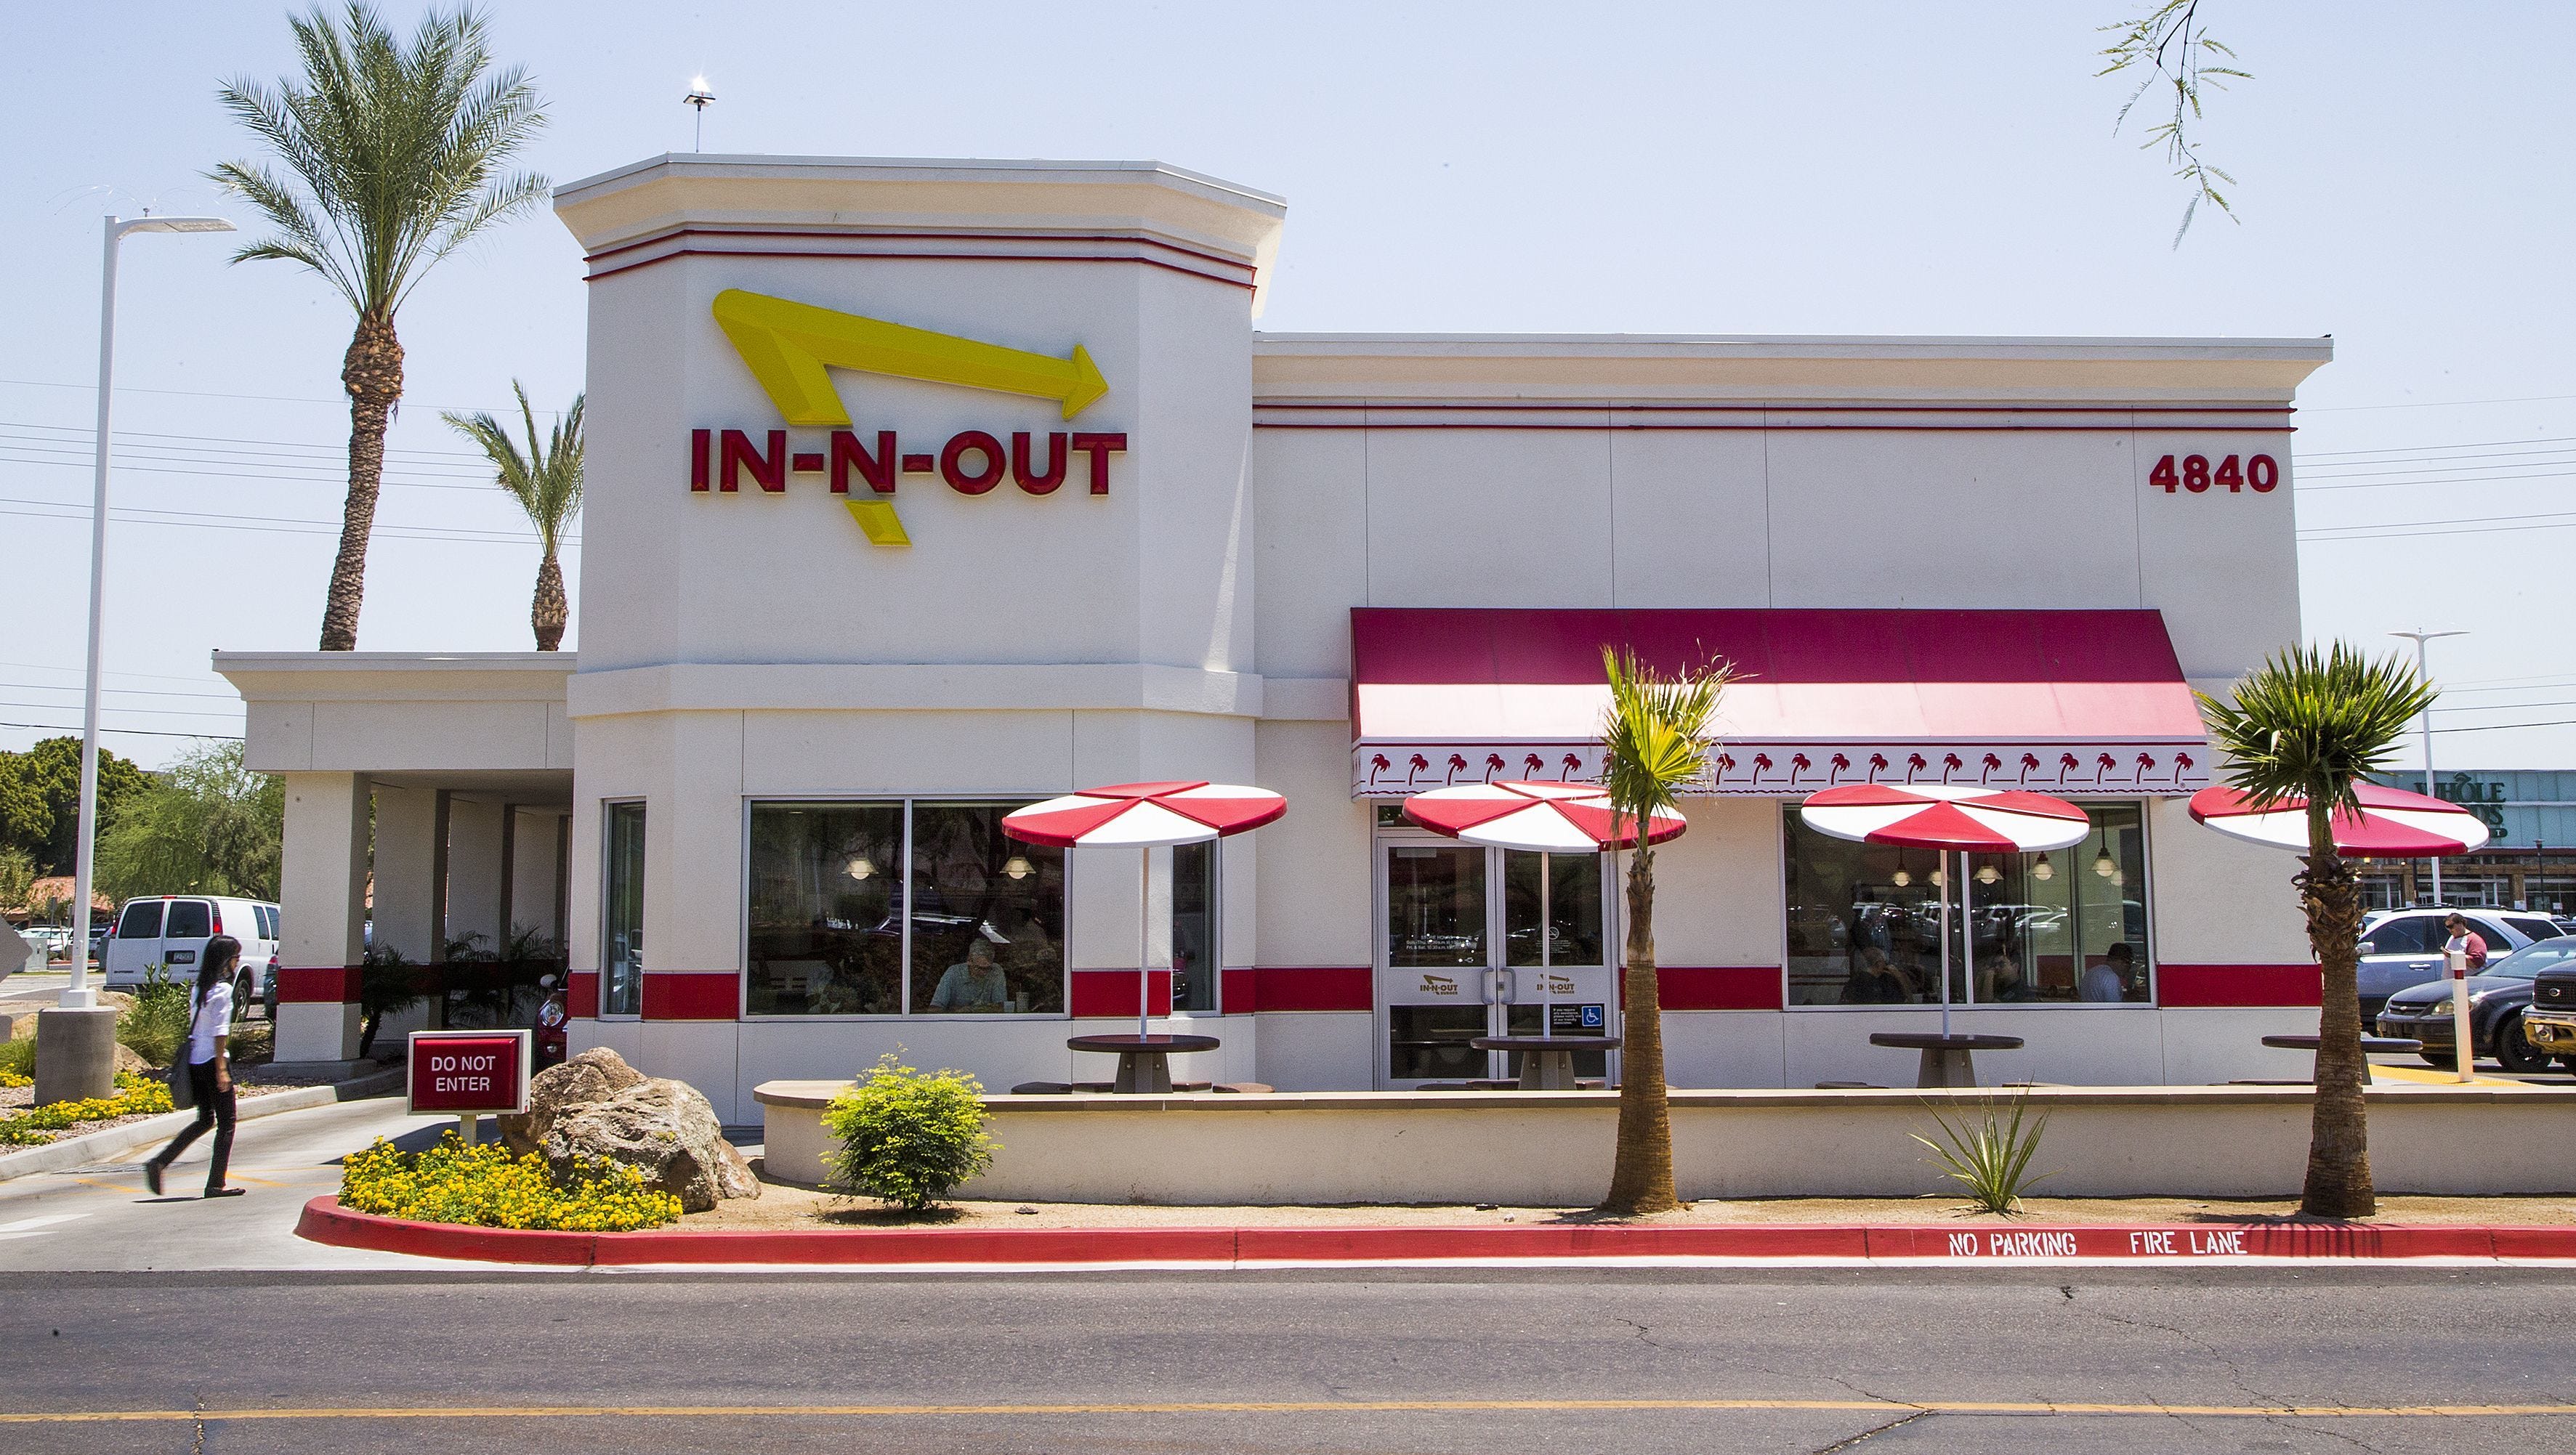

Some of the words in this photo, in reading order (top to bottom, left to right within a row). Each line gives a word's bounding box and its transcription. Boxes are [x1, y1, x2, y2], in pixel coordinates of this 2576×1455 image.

[691, 429, 1128, 495] IN-N-OUT
[2149, 454, 2280, 493] 4840
[432, 1056, 456, 1071] DO
[461, 1055, 496, 1071] NOT
[436, 1077, 490, 1092] ENTER
[1949, 1233, 1978, 1256] NO
[1990, 1232, 2077, 1256] PARKING
[2130, 1231, 2178, 1255] FIRE
[2190, 1231, 2248, 1255] LANE
